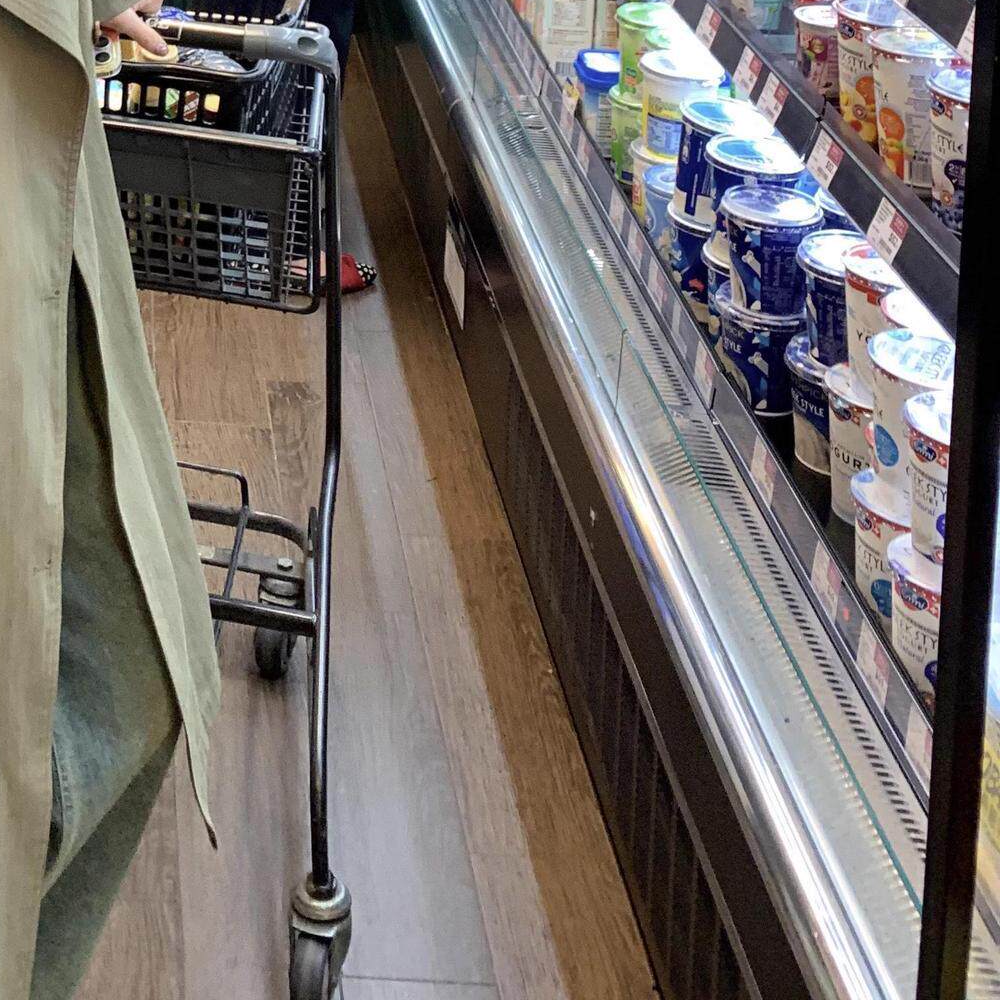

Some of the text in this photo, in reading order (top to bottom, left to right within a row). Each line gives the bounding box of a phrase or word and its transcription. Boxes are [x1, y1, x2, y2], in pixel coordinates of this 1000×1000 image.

[926, 482, 948, 502] STY
[862, 549, 885, 572] STYL
[915, 632, 938, 650] STY
